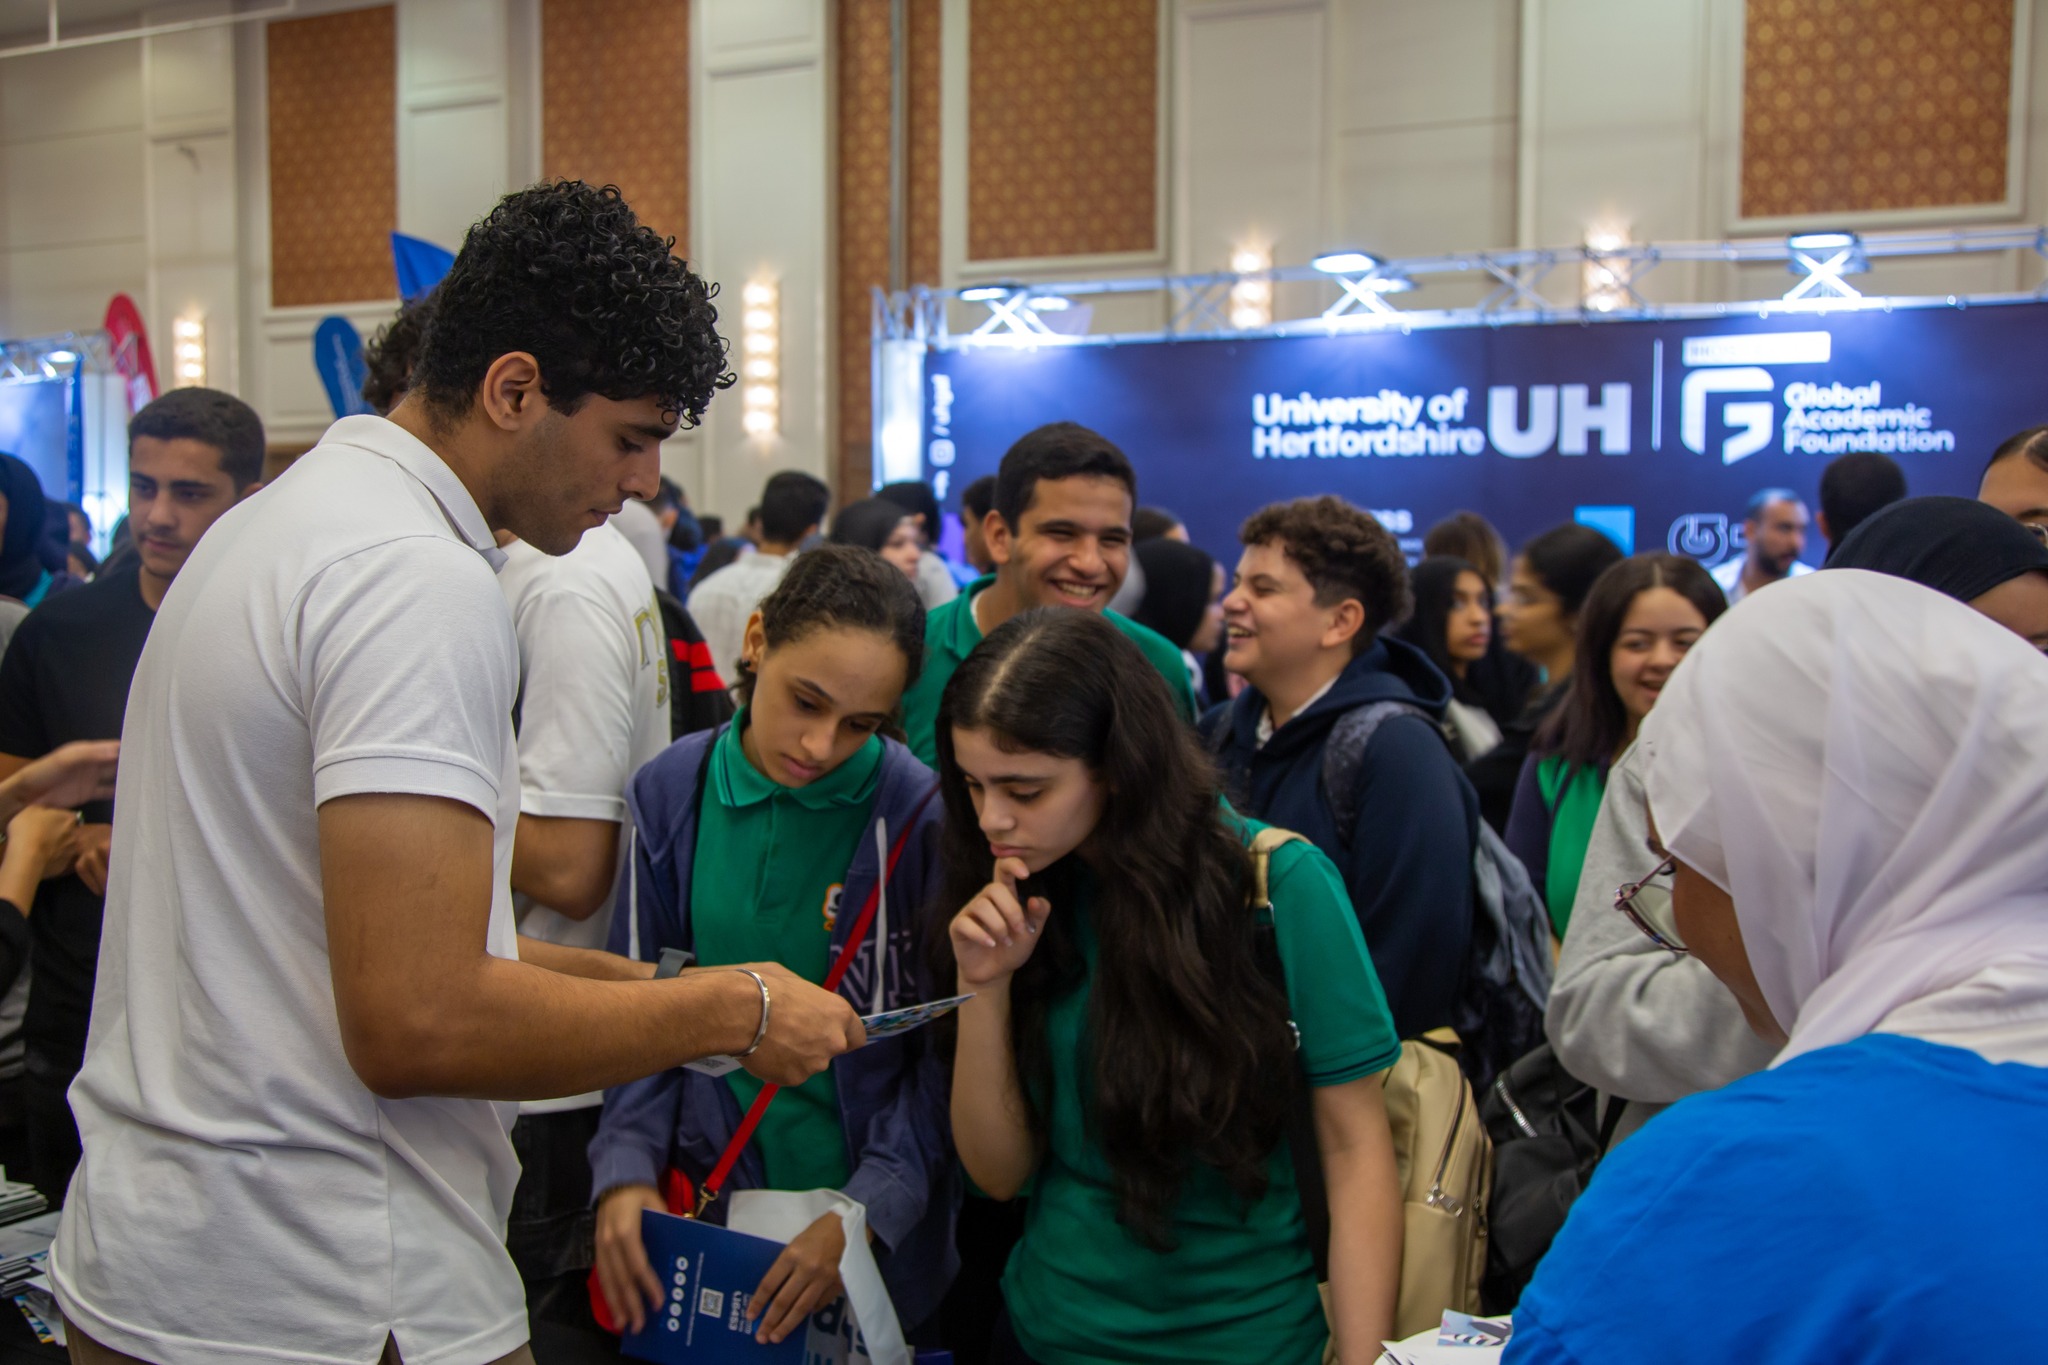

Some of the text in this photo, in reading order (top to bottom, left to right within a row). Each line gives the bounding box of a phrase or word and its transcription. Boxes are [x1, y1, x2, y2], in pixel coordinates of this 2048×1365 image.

[1252, 387, 1469, 428] University of
[1783, 380, 1881, 410] Global
[1487, 382, 1632, 458] UH
[1782, 402, 1932, 431] Academic
[1252, 421, 1486, 459] Hertfordshire
[1784, 427, 1955, 454] Foundation
